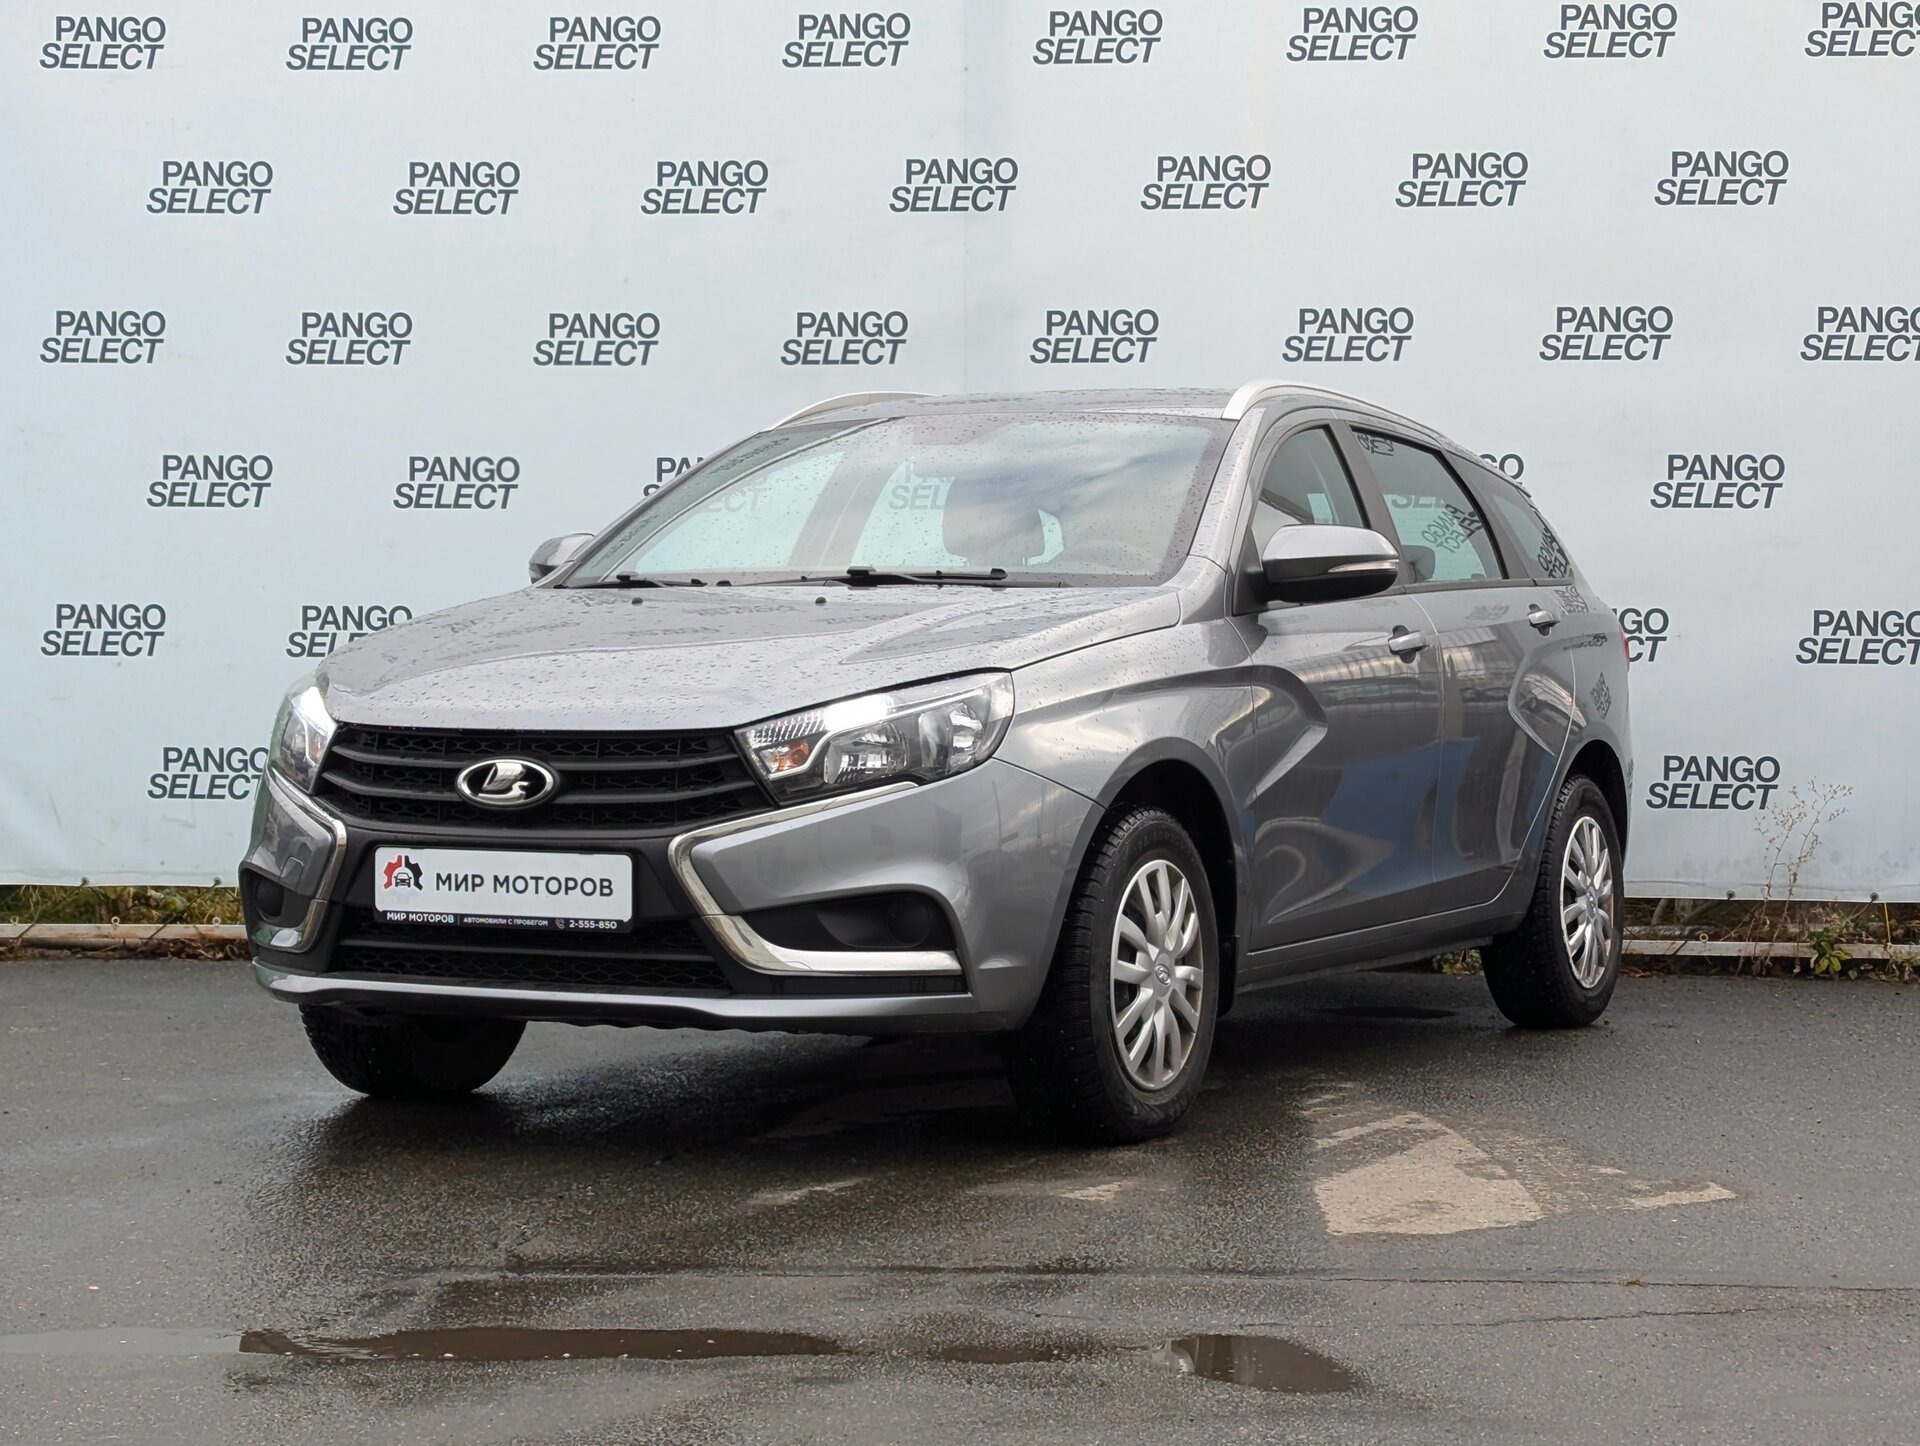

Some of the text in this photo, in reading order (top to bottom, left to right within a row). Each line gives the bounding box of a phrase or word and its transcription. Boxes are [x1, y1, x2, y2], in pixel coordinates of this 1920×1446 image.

[799, 13, 910, 40] PANGO
[1050, 9, 1163, 37] PANGO
[1304, 6, 1418, 33] PANGO
[1561, 3, 1677, 30] PANGO
[1822, 1, 1920, 28] PANG
[56, 16, 166, 43] PANGO
[302, 17, 413, 43] PANGO
[550, 16, 661, 42] PANGO
[40, 43, 164, 70] SELECT
[533, 43, 659, 70] SELECT
[782, 40, 909, 68] SELECT
[1033, 37, 1161, 65] SELECT
[1286, 34, 1416, 61] SELECT
[1544, 31, 1676, 58] SELECT
[1805, 29, 1920, 57] SELEC
[286, 44, 411, 71] SELECT
[163, 161, 273, 187] PANGO
[409, 162, 520, 188] PANGO
[657, 160, 768, 187] PANGO
[906, 158, 1018, 184] PANGO
[1157, 155, 1271, 182] PANGO
[1413, 152, 1528, 179] PANGO
[1672, 151, 1789, 177] PANGO
[146, 188, 271, 214] SELECT
[393, 189, 518, 215] SELECT
[641, 188, 767, 214] SELECT
[889, 185, 1016, 212] SELECT
[1140, 183, 1269, 210] SELECT
[1395, 180, 1526, 207] SELECT
[1654, 178, 1787, 205] SELECT
[56, 311, 166, 337] PANGO
[302, 312, 412, 338] PANGO
[549, 313, 660, 339] PANGO
[797, 311, 908, 337] PANGO
[1047, 309, 1159, 336] PANGO
[1299, 307, 1414, 334] PANGO
[1556, 306, 1673, 333] PANGO
[40, 337, 164, 364] SELECT
[286, 339, 411, 365] SELECT
[533, 340, 659, 366] SELECT
[781, 339, 907, 365] SELECT
[1030, 337, 1157, 364] SELECT
[1282, 335, 1412, 362] SELECT
[1539, 334, 1671, 361] SELECT
[163, 455, 273, 481] PANGO
[409, 456, 520, 482] PANGO
[1668, 454, 1785, 481] PANGO
[147, 481, 271, 508] SELECT
[393, 483, 518, 509] SELECT
[1650, 482, 1783, 509] SELECT
[56, 604, 166, 630] PANGO
[302, 605, 412, 631] PANGO
[41, 630, 165, 656] SELECT
[163, 747, 269, 773] PANGO
[1664, 755, 1780, 783] PANGO
[147, 773, 261, 800] SELEC
[1646, 782, 1778, 810] SELECT
[436, 872, 614, 897] МИР МОТОРОВ
[386, 911, 407, 921] МИР
[408, 913, 455, 923] МОТОРОВ
[463, 917, 507, 925] АВТОМОБИЛИ
[569, 920, 618, 929] 2-555-850
